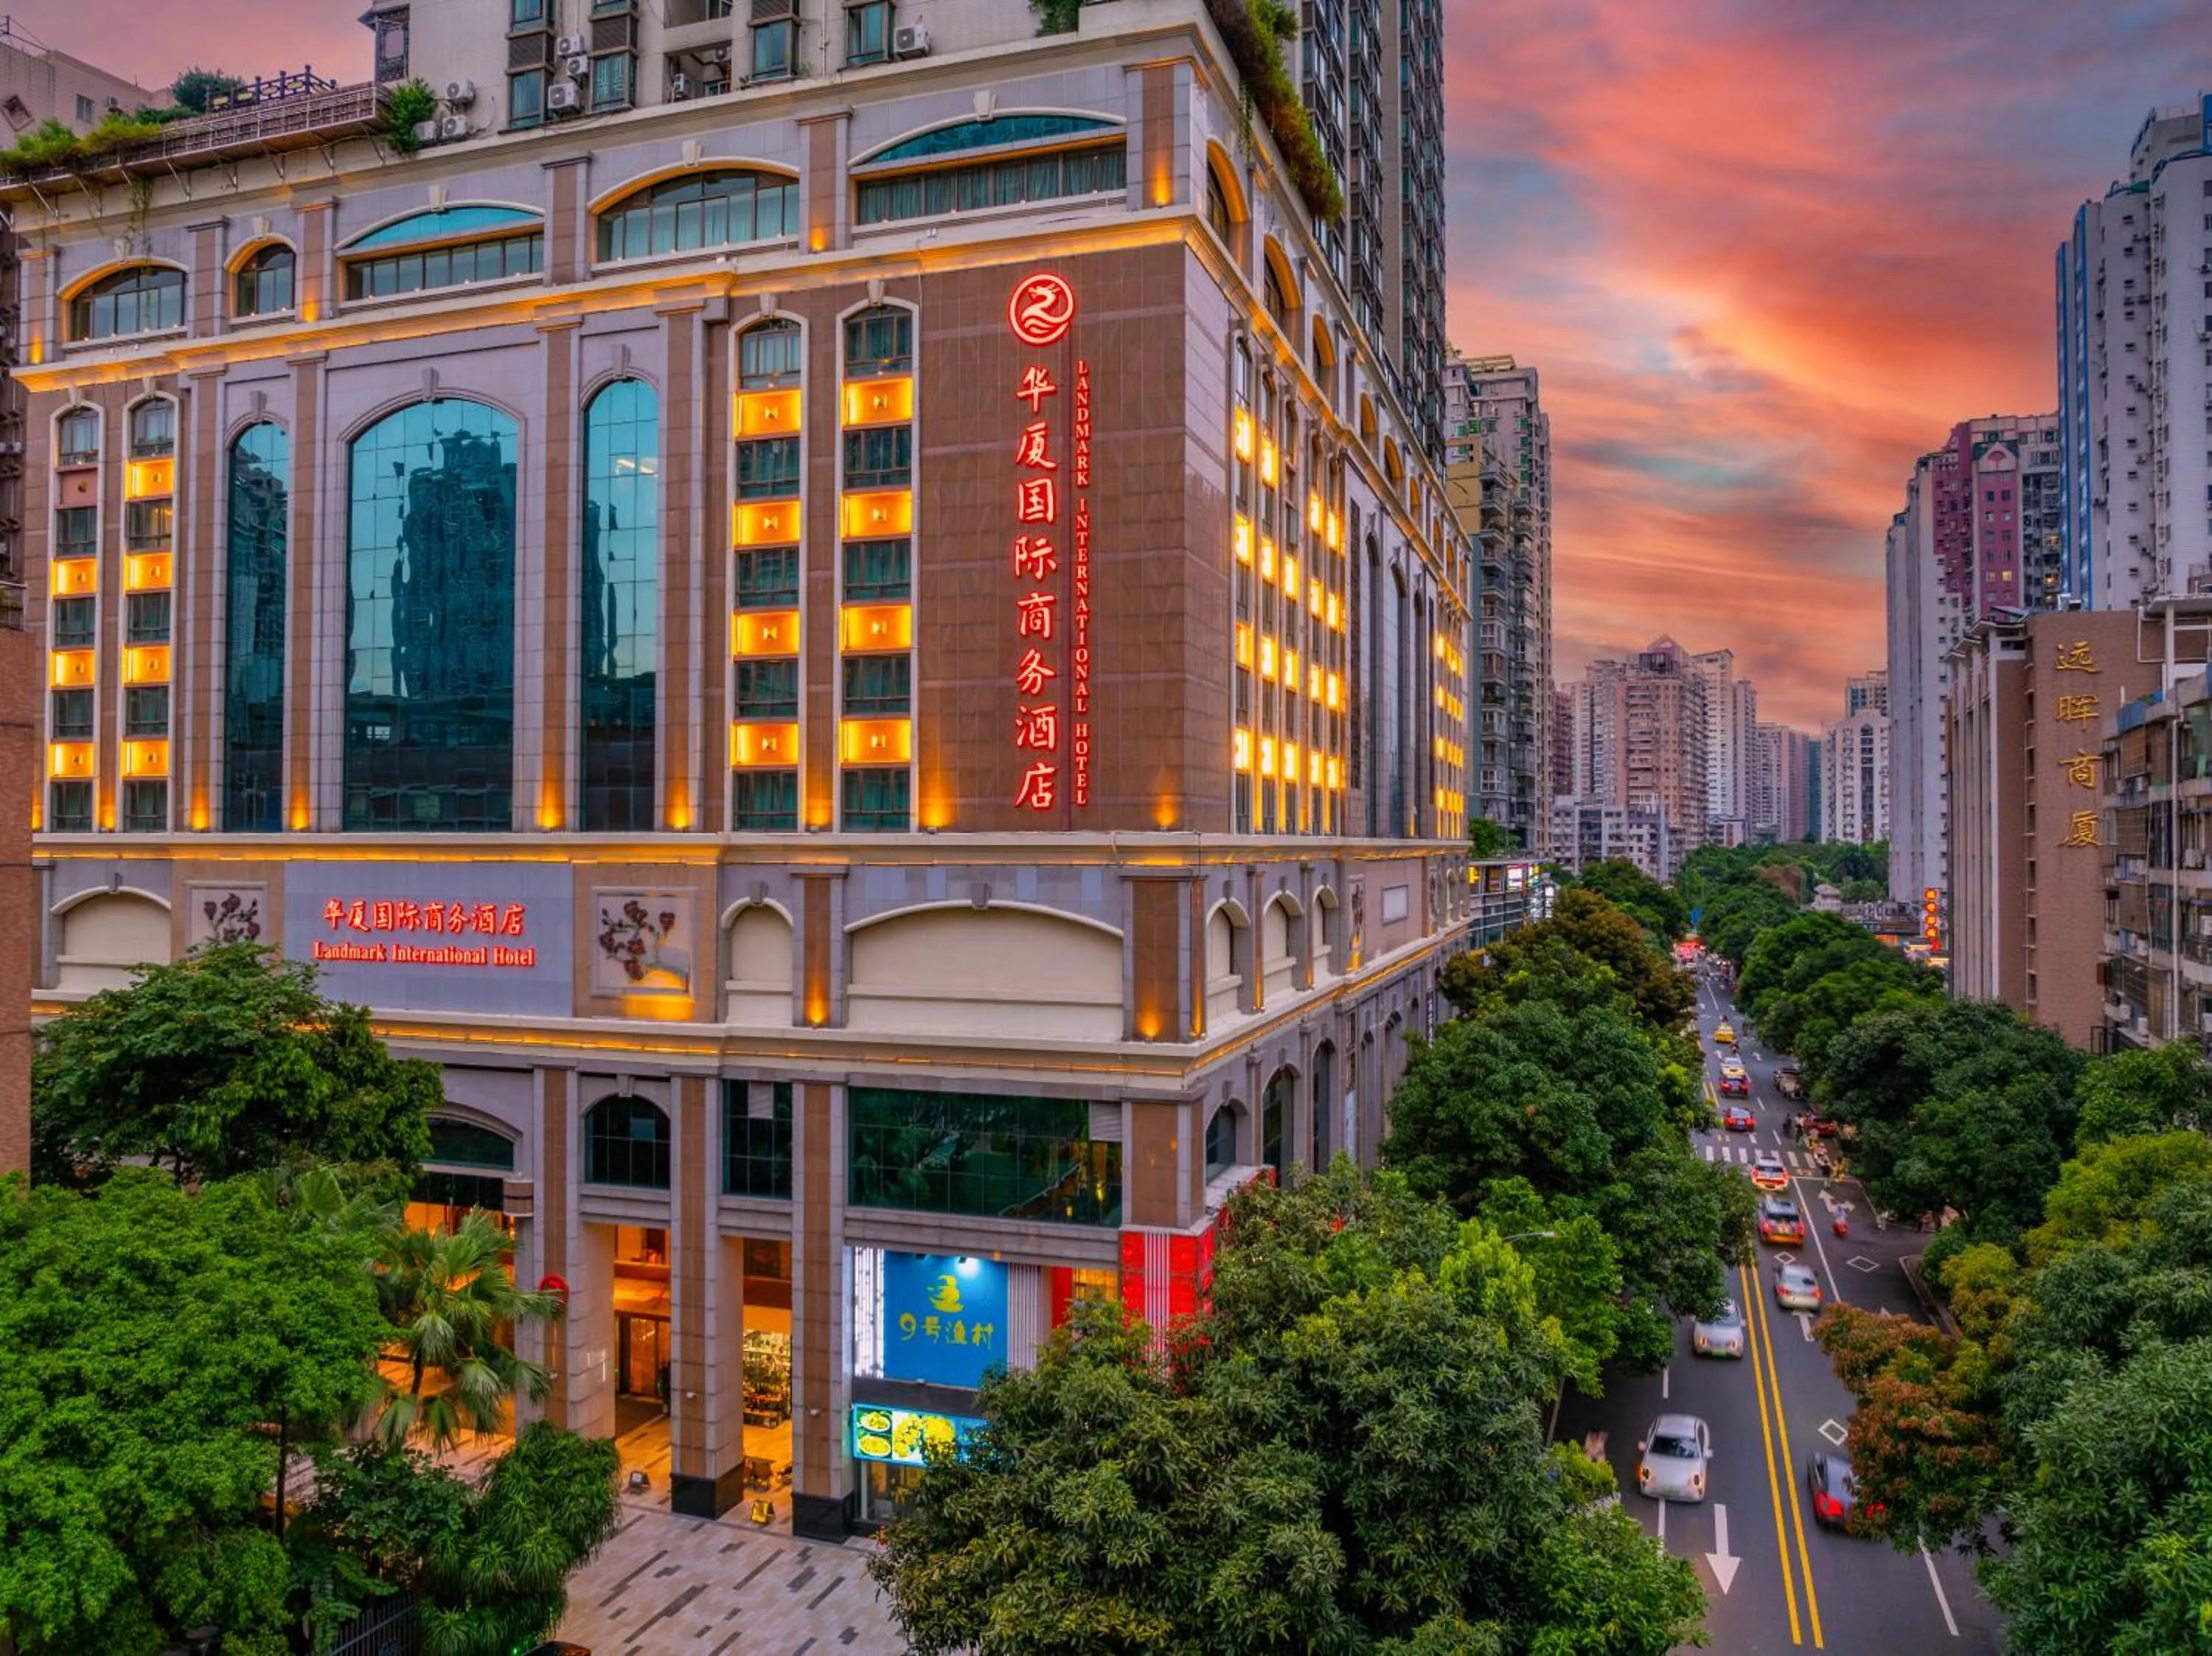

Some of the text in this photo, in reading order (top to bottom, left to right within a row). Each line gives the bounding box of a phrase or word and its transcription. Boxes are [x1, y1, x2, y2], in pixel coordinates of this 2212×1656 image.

[1015, 366, 1057, 809] 华厦国际商务酒店
[1074, 359, 1091, 805] LANDMARK INTERNATIONAL HOTEL
[2056, 641, 2103, 847] 远晖商厦
[313, 940, 535, 967] Landmark International Hotel
[324, 899, 525, 934] 华厦国际商务酒店
